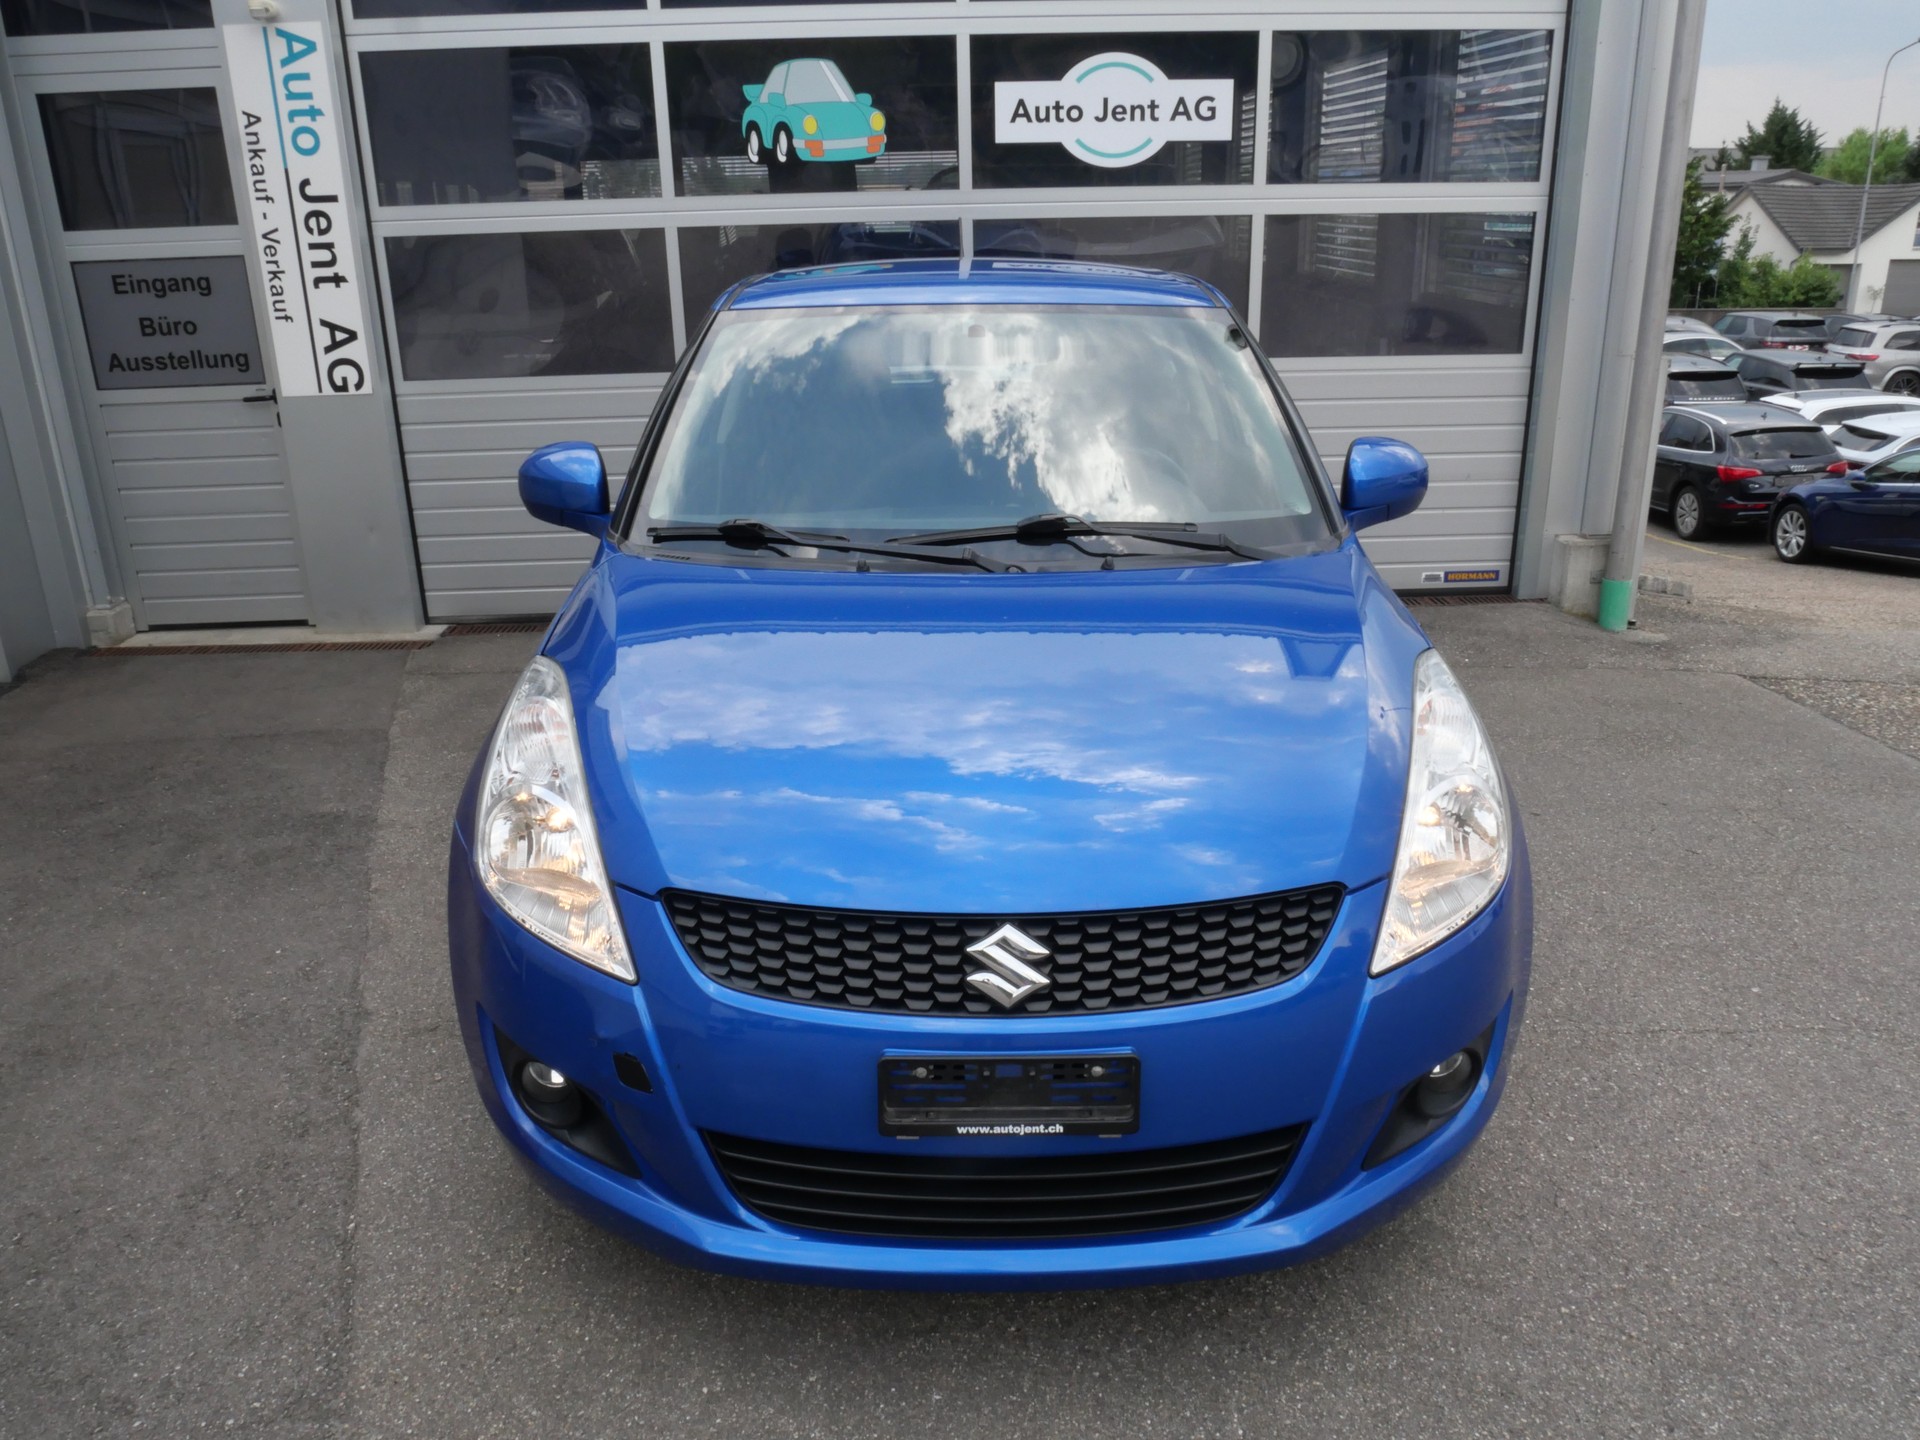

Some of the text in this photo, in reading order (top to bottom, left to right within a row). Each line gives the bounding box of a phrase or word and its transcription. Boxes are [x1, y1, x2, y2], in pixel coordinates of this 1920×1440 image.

[1010, 96, 1217, 123] Auto Jent AG
[241, 110, 275, 204] Ankauf
[261, 227, 293, 324] Verkauf
[275, 27, 365, 394] Auto Jent AG
[111, 274, 212, 298] Eingang
[139, 316, 198, 337] Büro
[108, 350, 250, 373] Ausstellung
[956, 1124, 1064, 1135] www.autojent.ch
